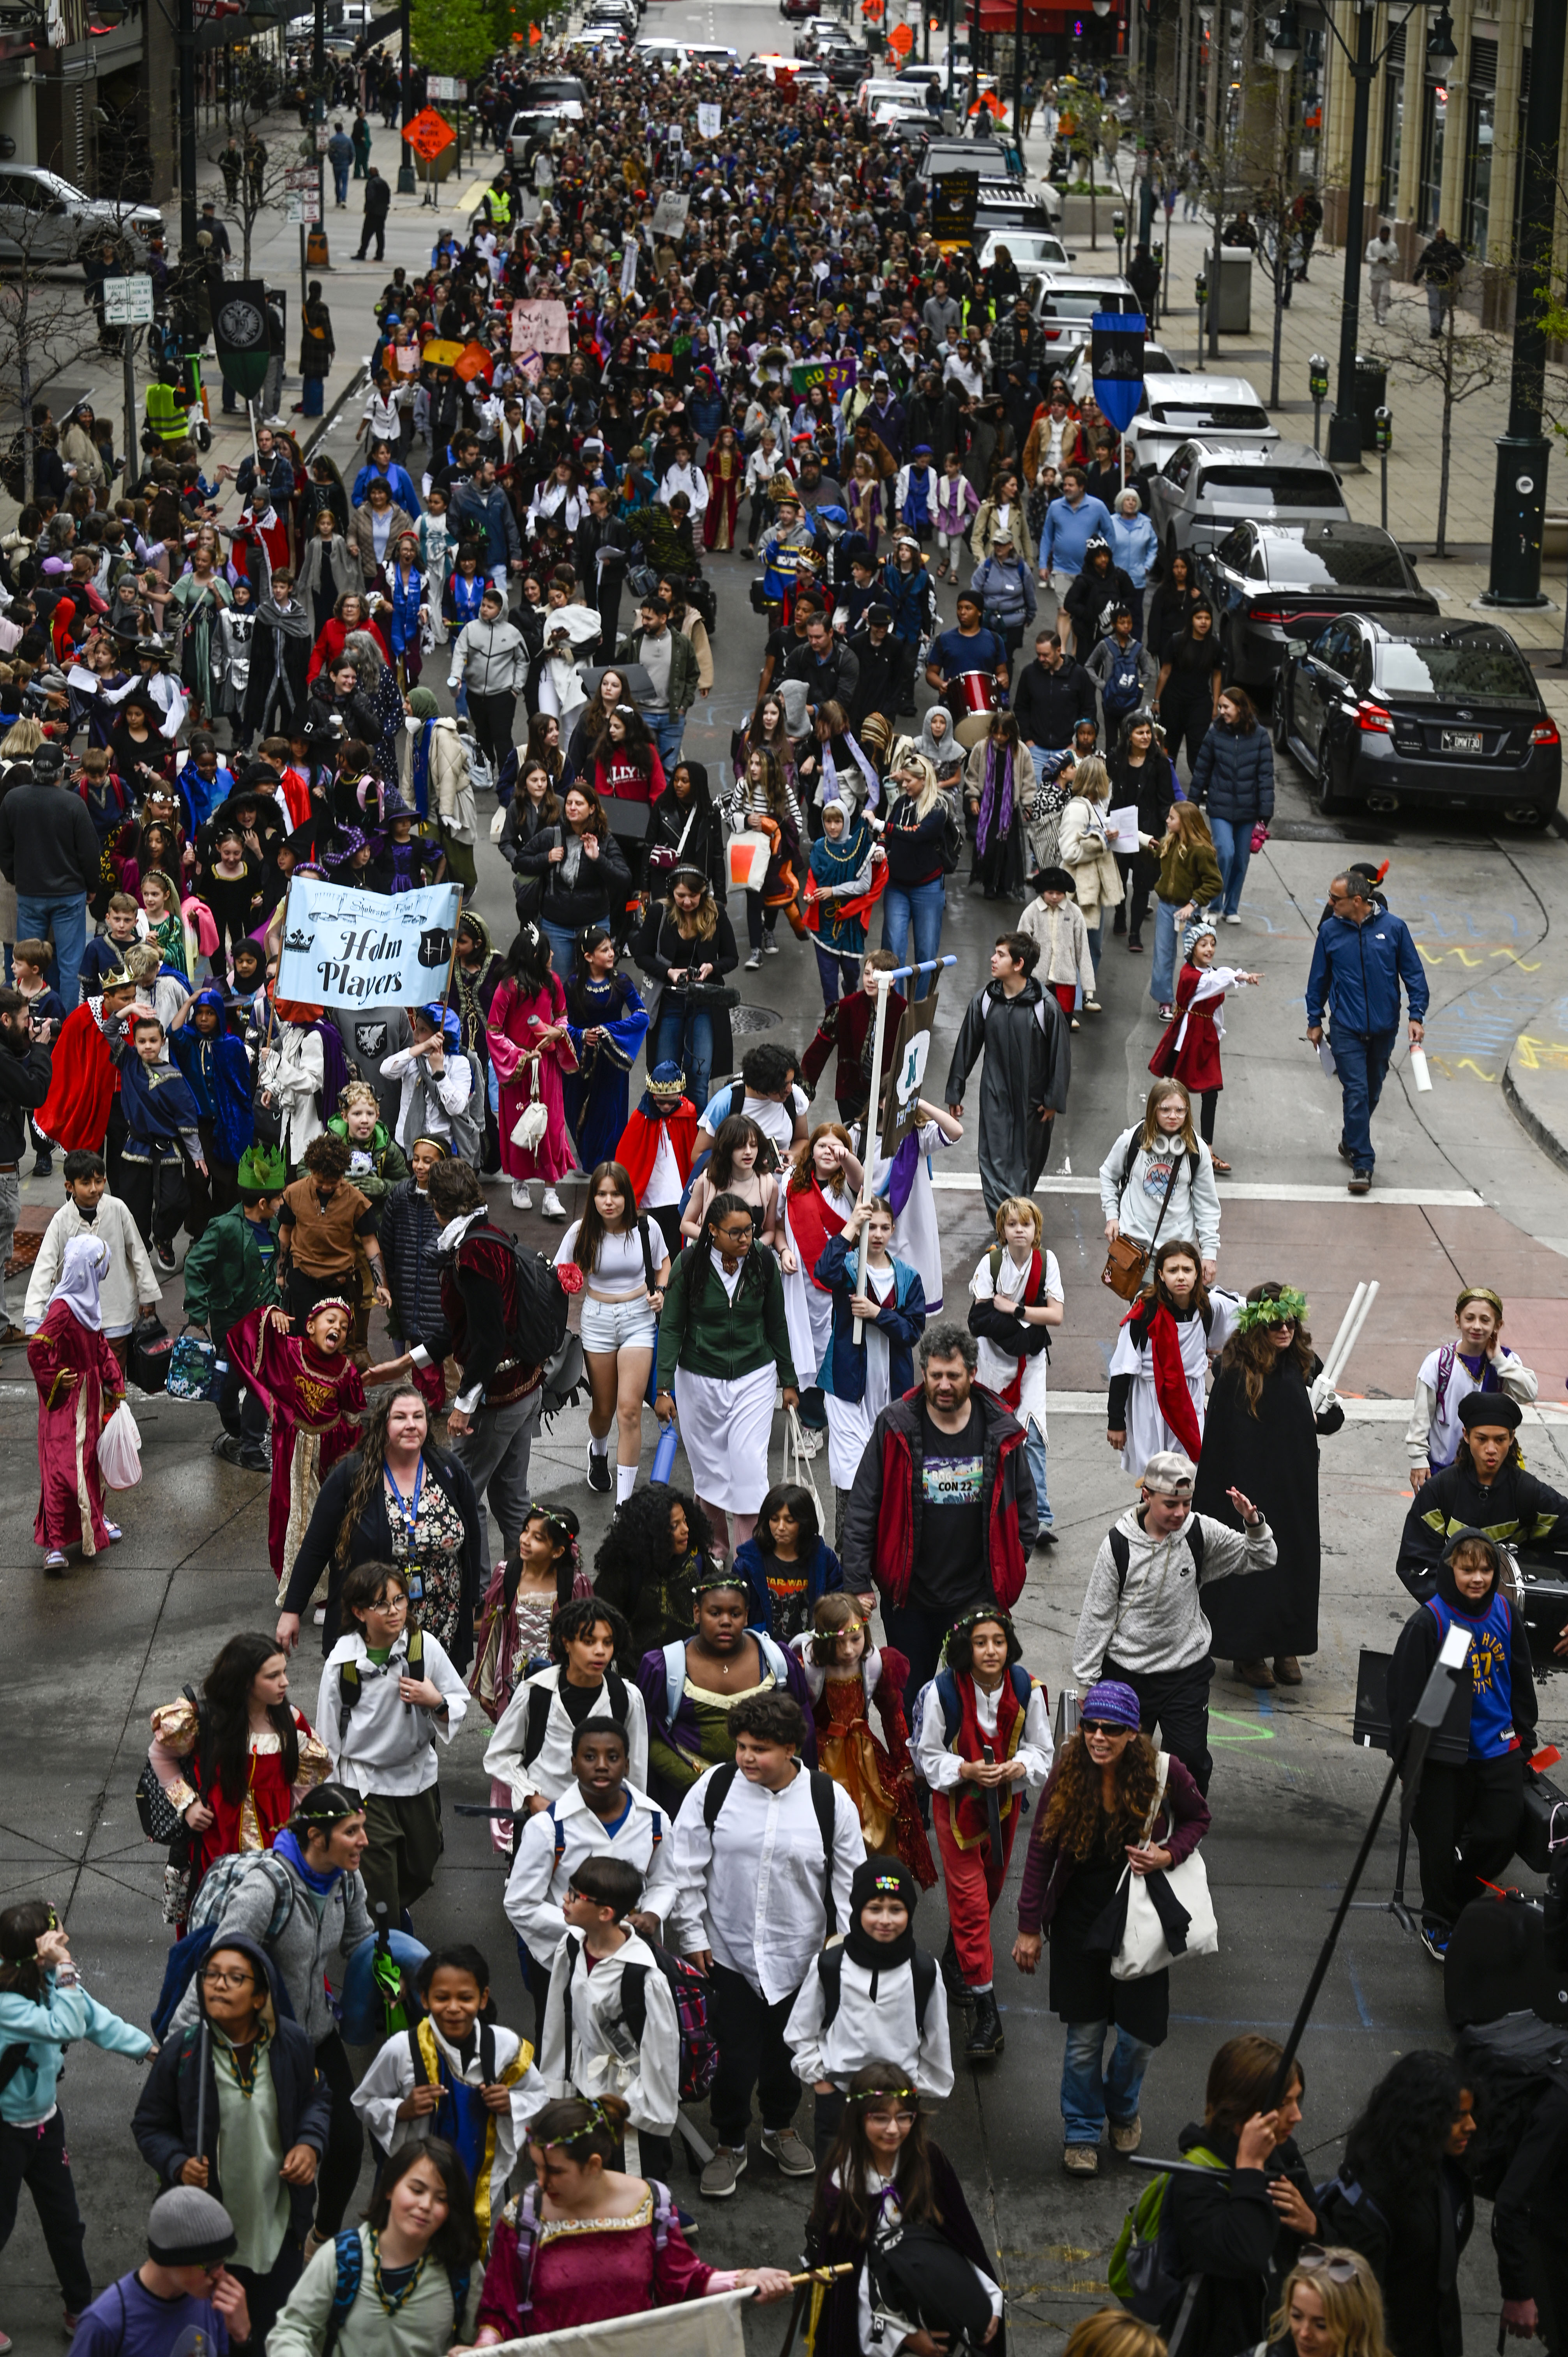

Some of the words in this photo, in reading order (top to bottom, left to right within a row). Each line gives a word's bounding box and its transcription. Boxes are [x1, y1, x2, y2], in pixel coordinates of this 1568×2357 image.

[333, 929, 402, 961] Holm
[317, 962, 402, 1005] Players
[938, 1482, 958, 1491] CON
[961, 1481, 972, 1491] 22
[1482, 1631, 1505, 1661] HIGH
[1471, 1652, 1492, 1679] 27
